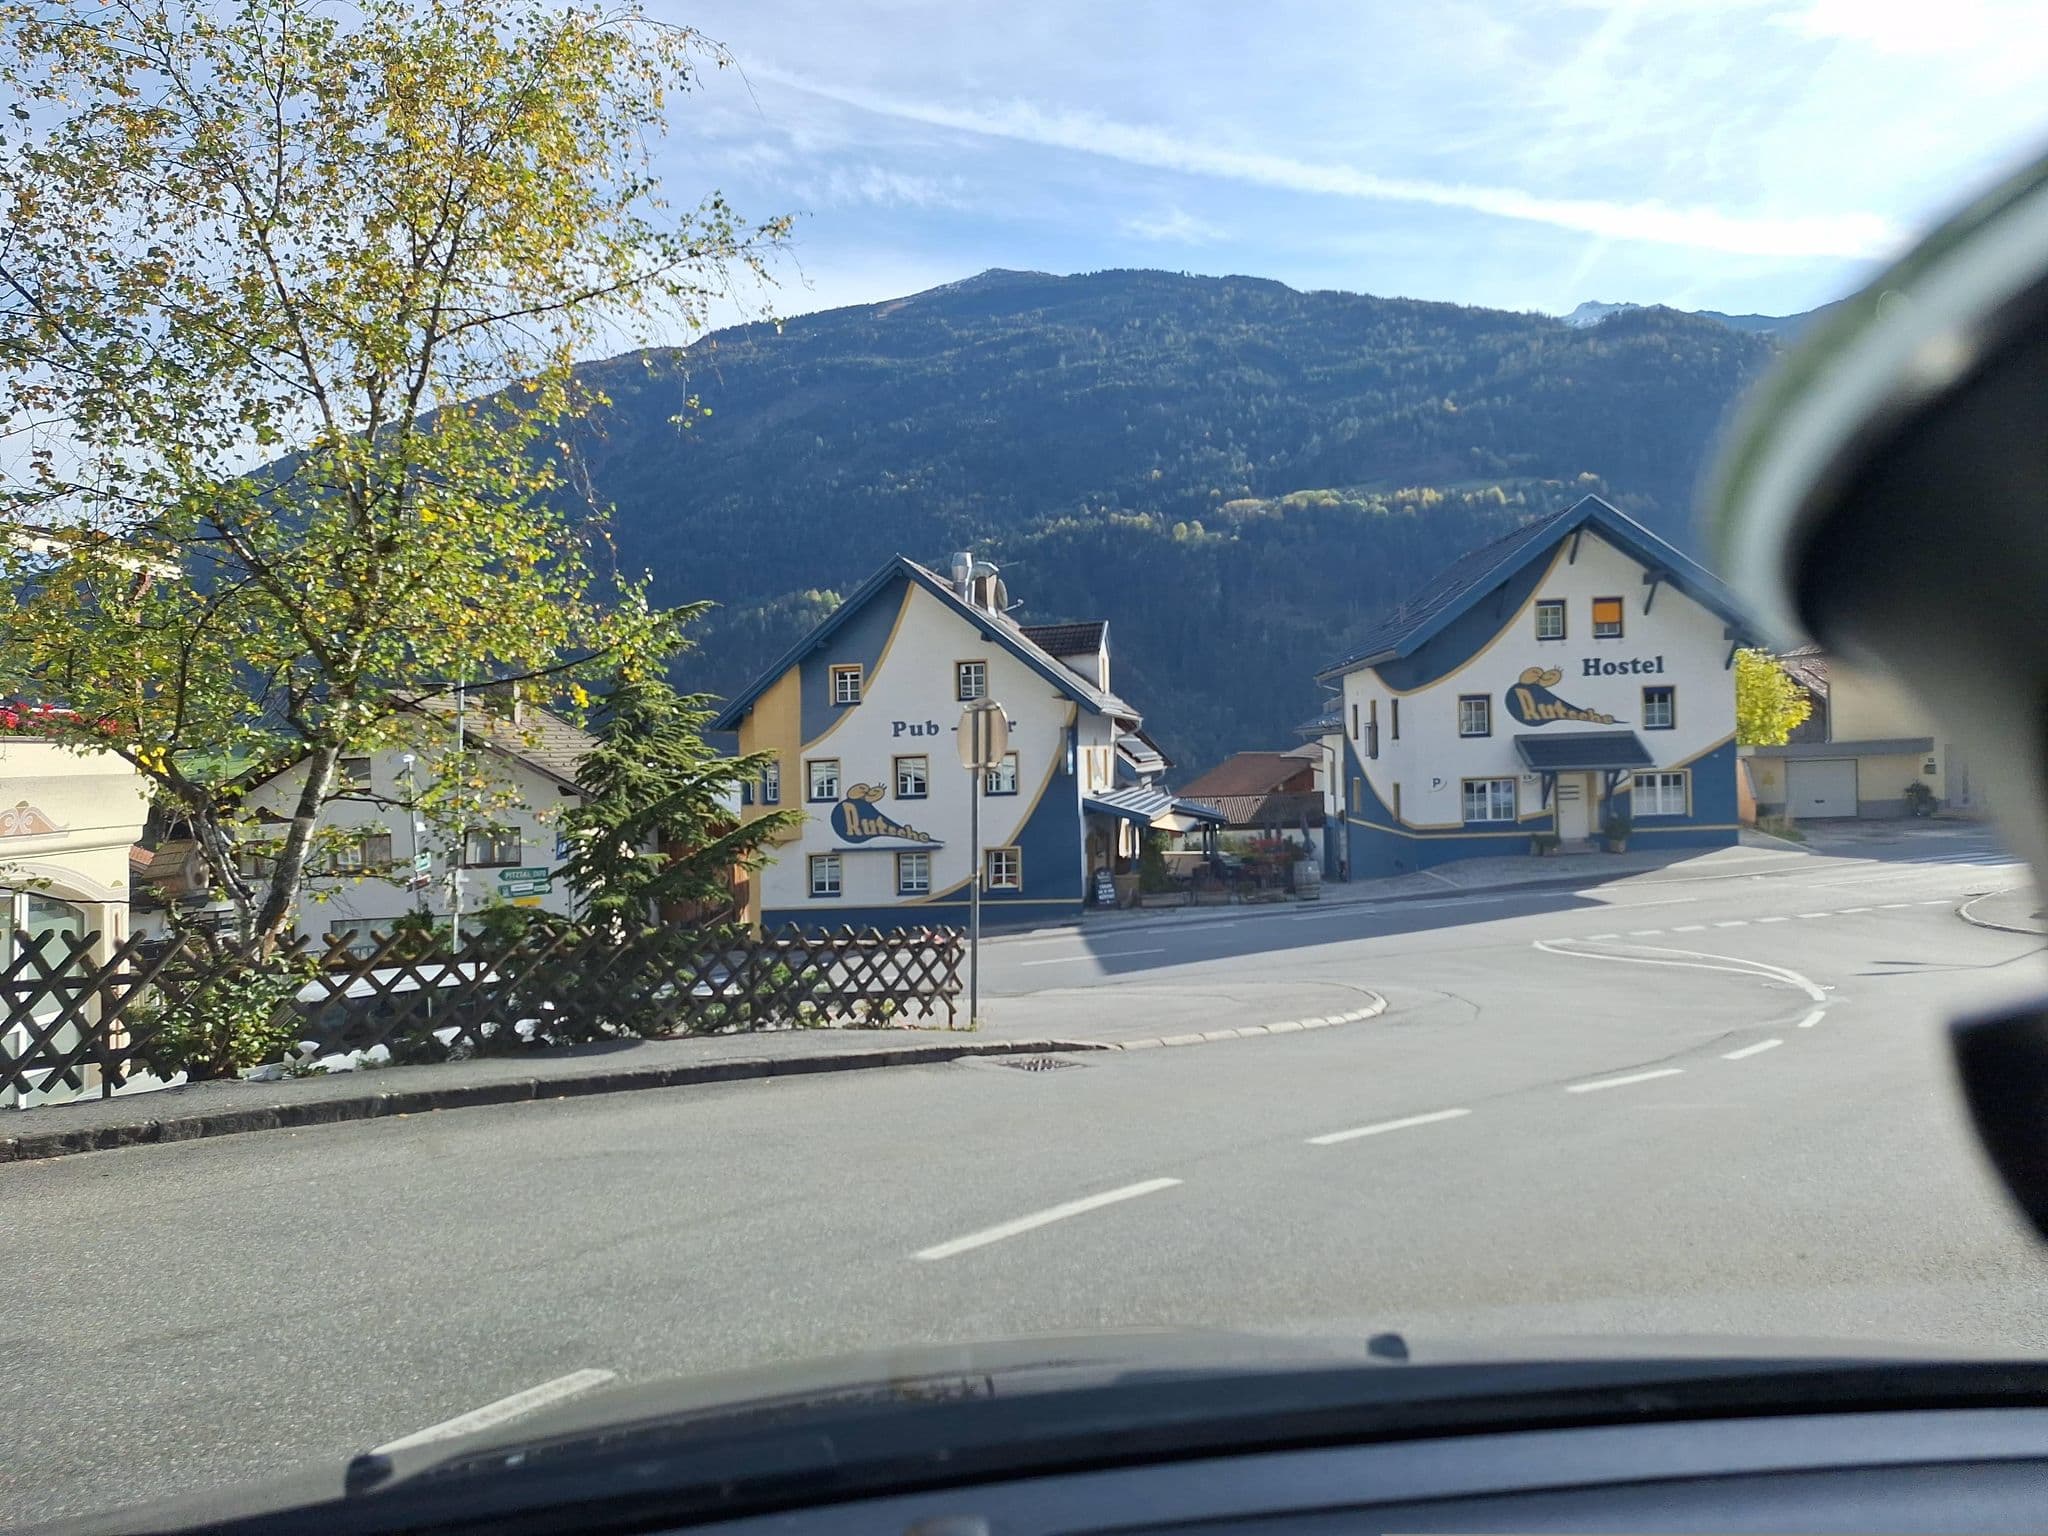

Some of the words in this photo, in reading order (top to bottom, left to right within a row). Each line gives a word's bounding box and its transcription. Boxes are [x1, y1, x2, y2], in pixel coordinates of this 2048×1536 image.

[1582, 656, 1664, 677] Hostel
[1514, 687, 1614, 725] Rutsche
[892, 720, 939, 738] Pub
[842, 801, 930, 843] Rutsche
